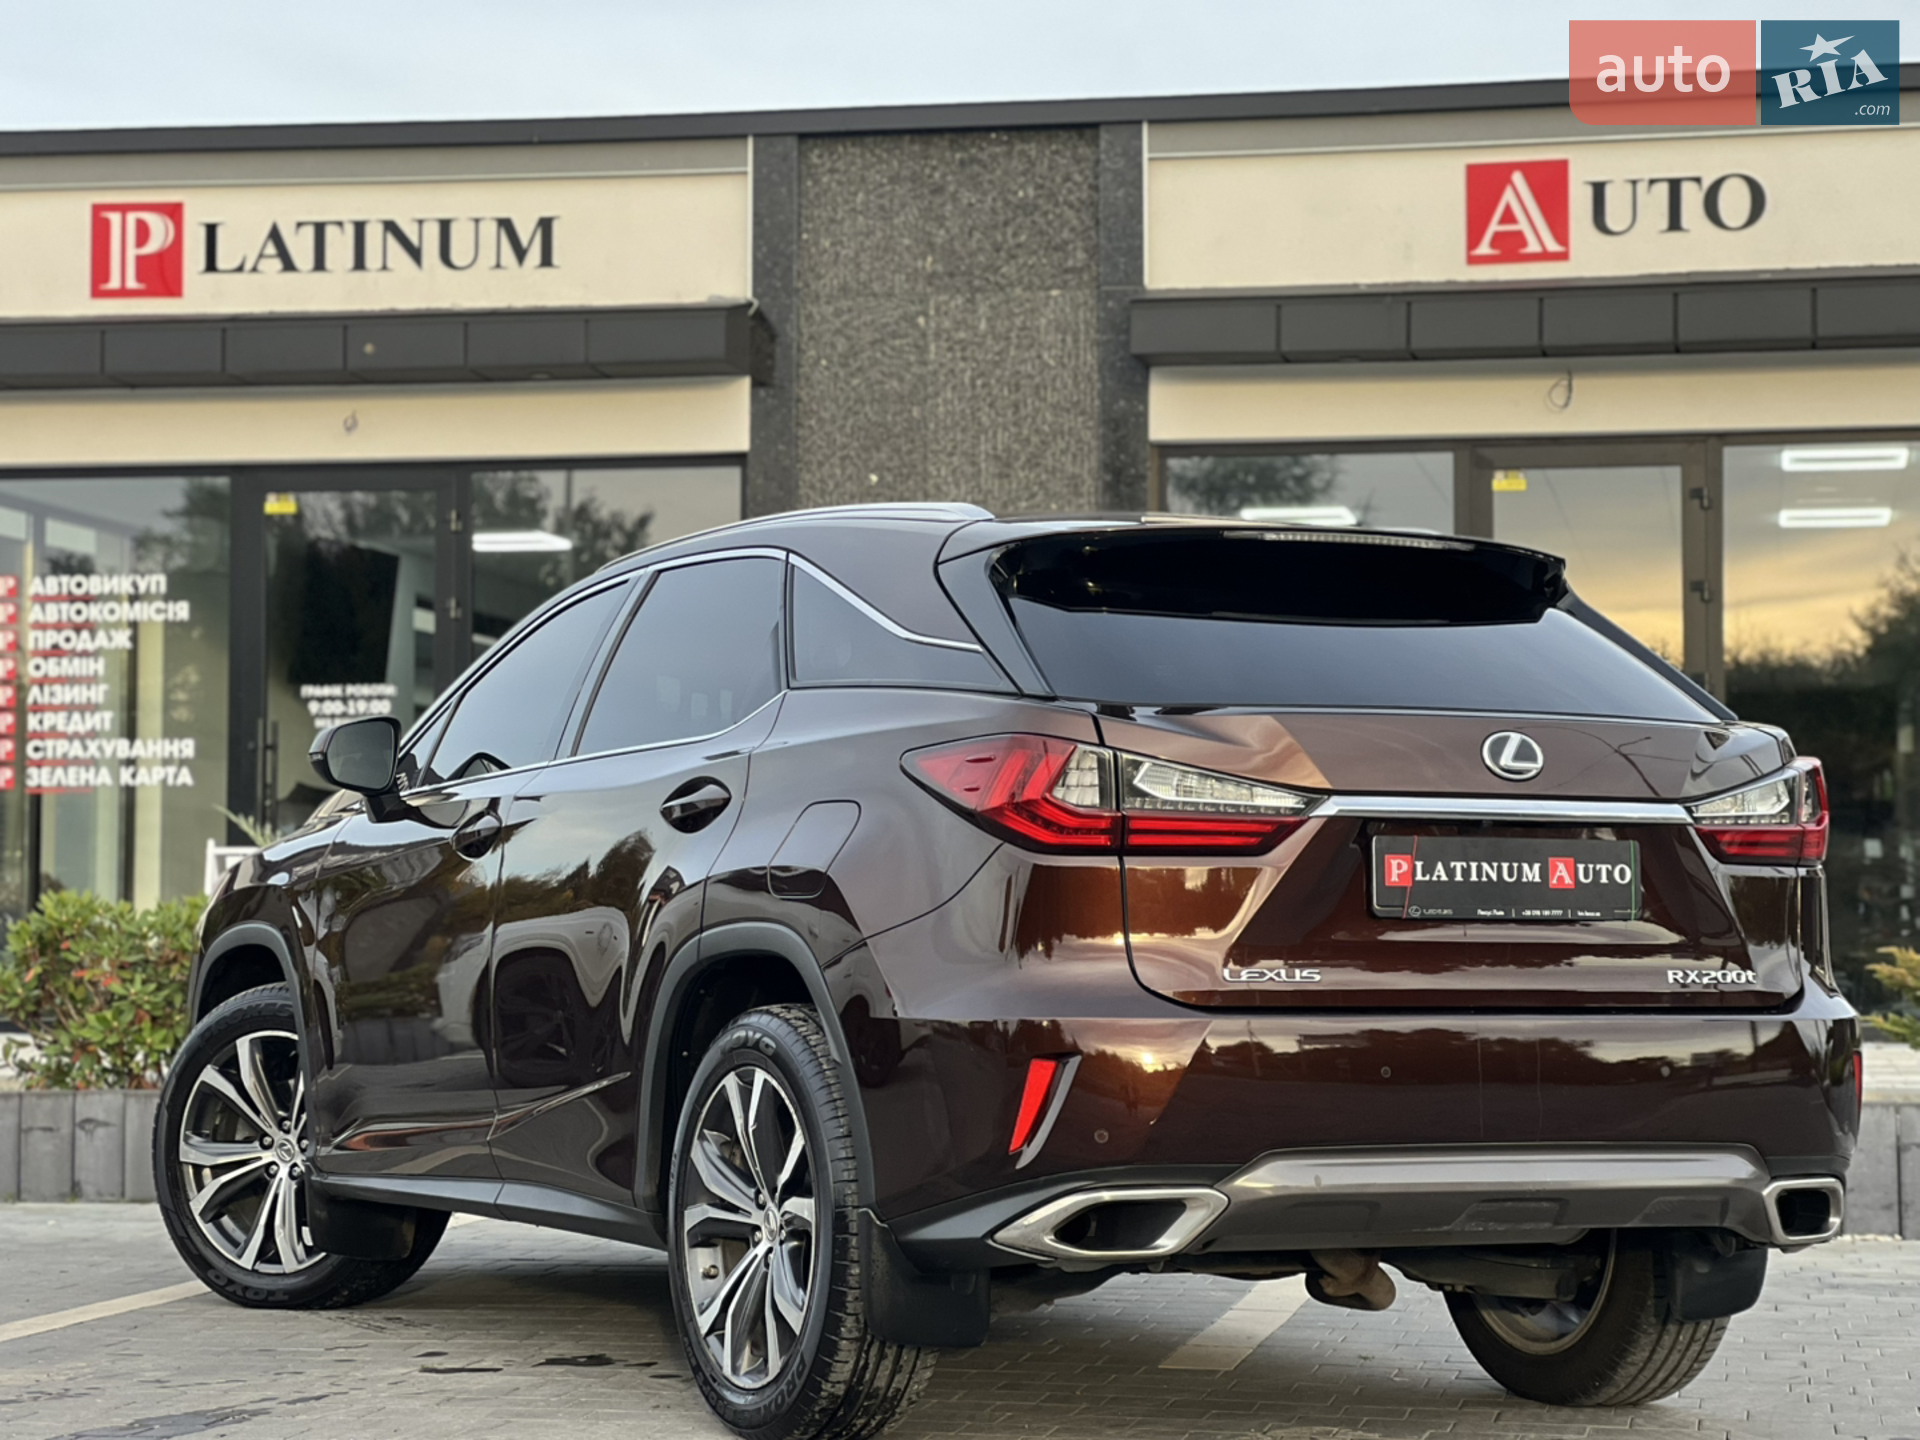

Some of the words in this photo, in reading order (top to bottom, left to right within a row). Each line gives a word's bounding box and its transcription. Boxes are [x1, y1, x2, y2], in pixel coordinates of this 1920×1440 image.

[1469, 169, 1767, 256] AUTO
[99, 210, 561, 290] PLATINUM
[29, 574, 167, 595] АВТОВИКУП
[29, 601, 190, 622] АВТОКОМІСІЯ
[28, 629, 133, 652] ПРОДАЖ
[27, 656, 104, 678] ОБМІН
[26, 684, 109, 704] ЛІЗИНГ
[26, 711, 113, 734] КРЕДИТ
[25, 738, 195, 760] СТРАХУВАННЯ
[25, 766, 113, 787] ЗЕЛЕНА
[119, 765, 194, 786] КАРТА
[1389, 859, 1541, 882] PLATINUM
[1551, 861, 1632, 885] AUTO
[1223, 968, 1322, 983] LEXUS
[1667, 969, 1757, 984] RX200t
